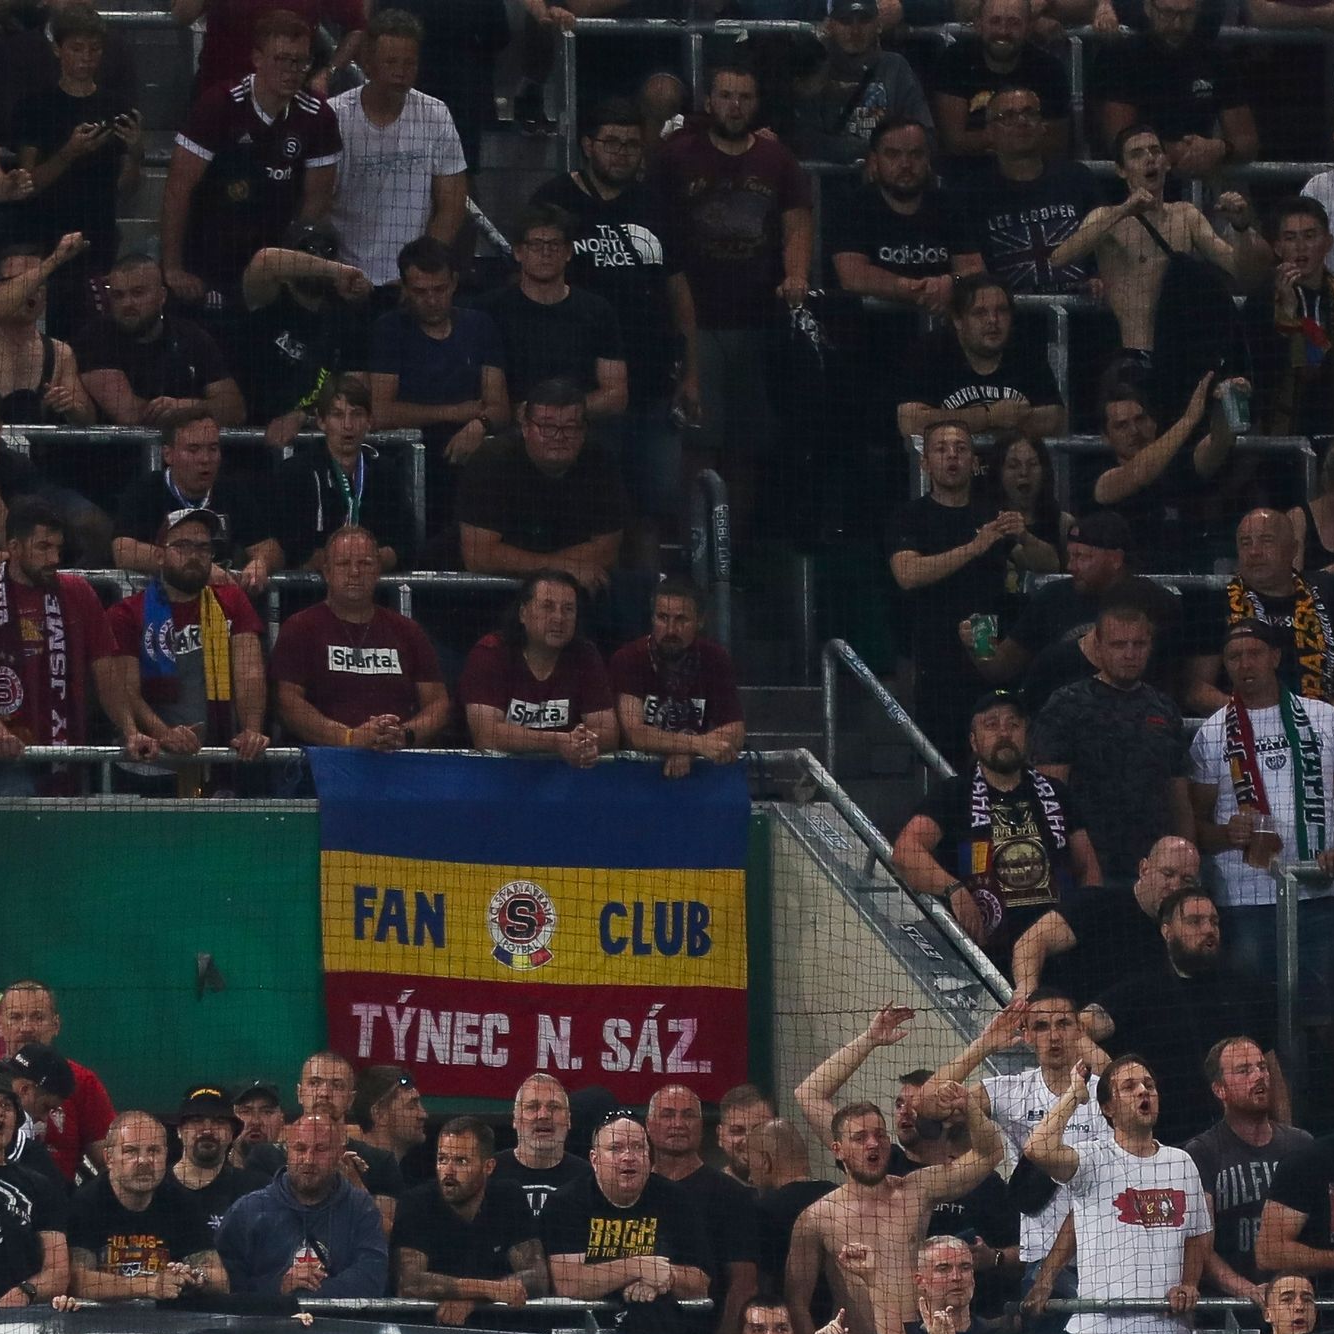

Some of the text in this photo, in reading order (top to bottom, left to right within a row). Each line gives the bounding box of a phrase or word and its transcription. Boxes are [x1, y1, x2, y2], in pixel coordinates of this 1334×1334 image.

[595, 251, 636, 268] FACE
[879, 244, 949, 265] adidas
[943, 386, 979, 411] OREVER
[353, 884, 713, 957] FAN CLUB
[350, 989, 713, 1075] TÝNEC N. SÁZ.
